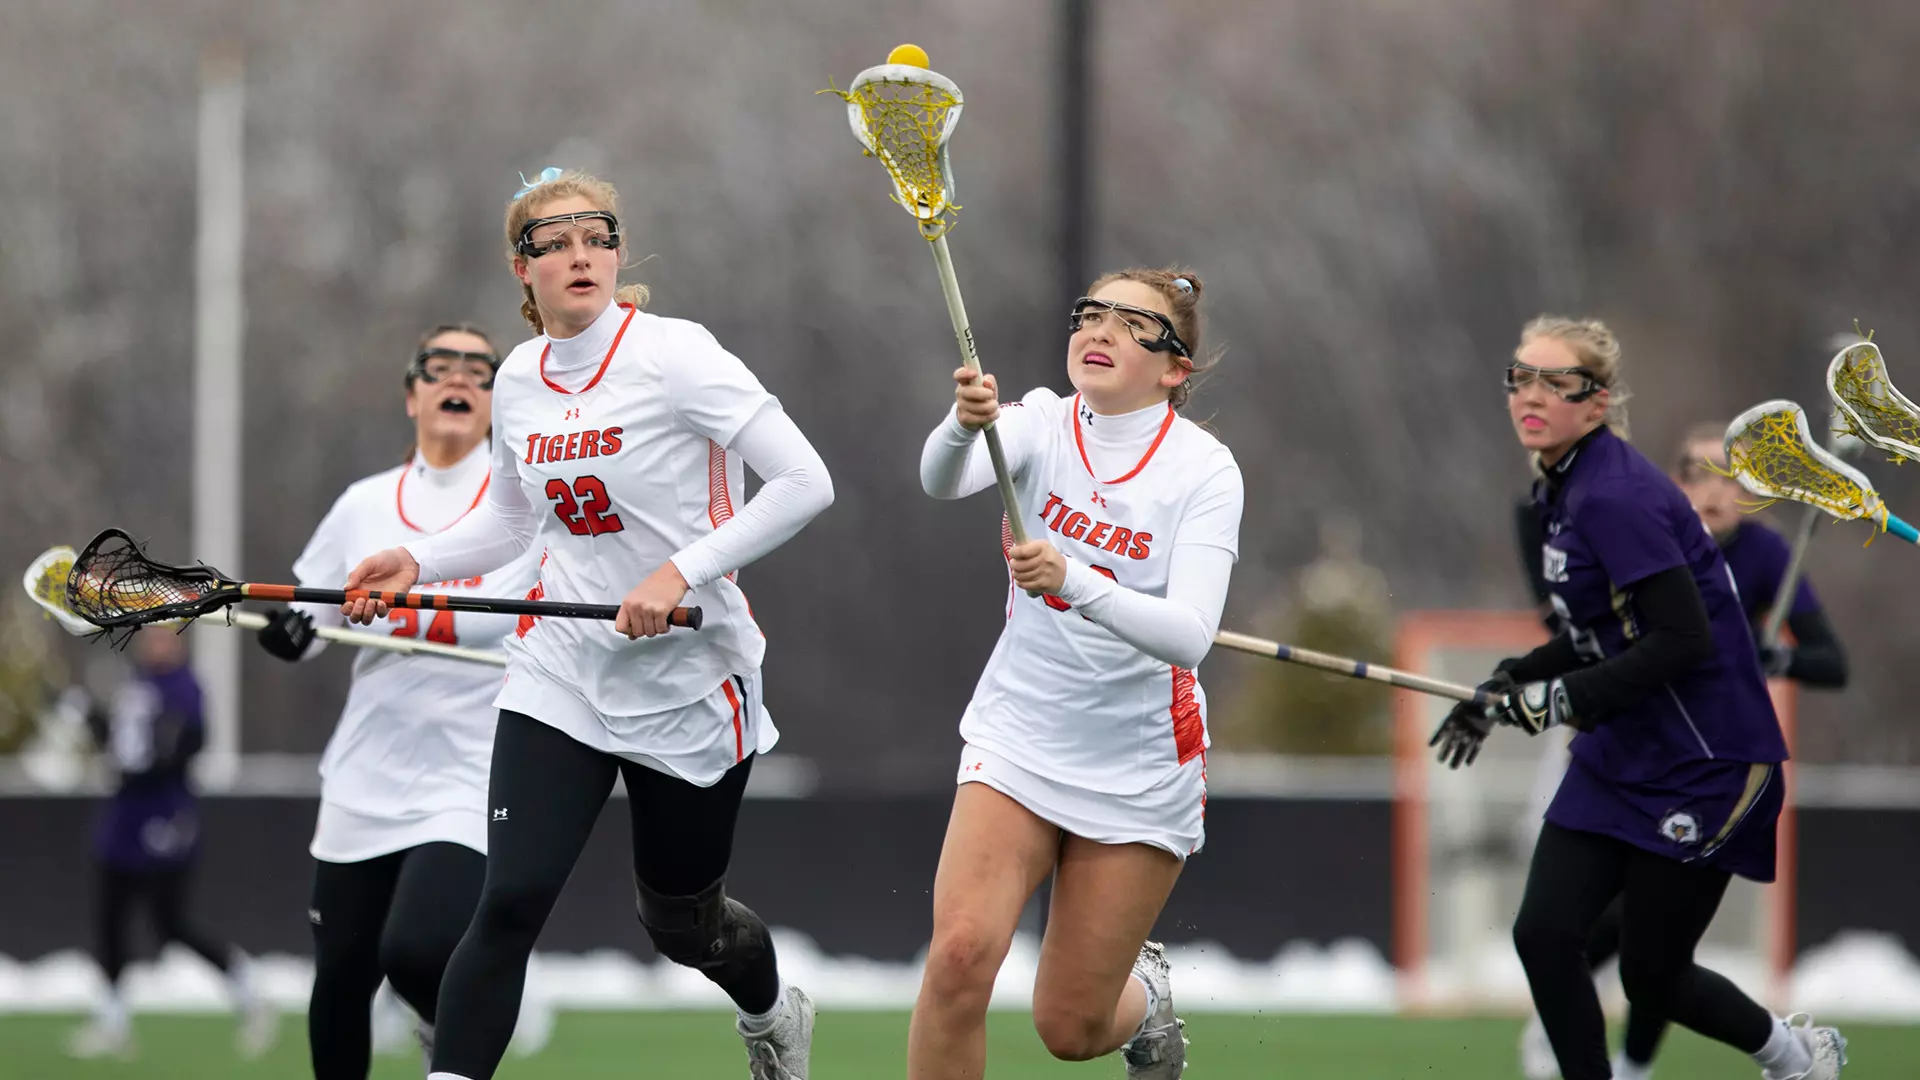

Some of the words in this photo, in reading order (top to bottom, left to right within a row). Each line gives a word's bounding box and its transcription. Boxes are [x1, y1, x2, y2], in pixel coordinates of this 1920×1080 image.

[525, 426, 624, 465] TIGERS
[545, 475, 625, 538] 22
[1038, 490, 1154, 561] TIGERS
